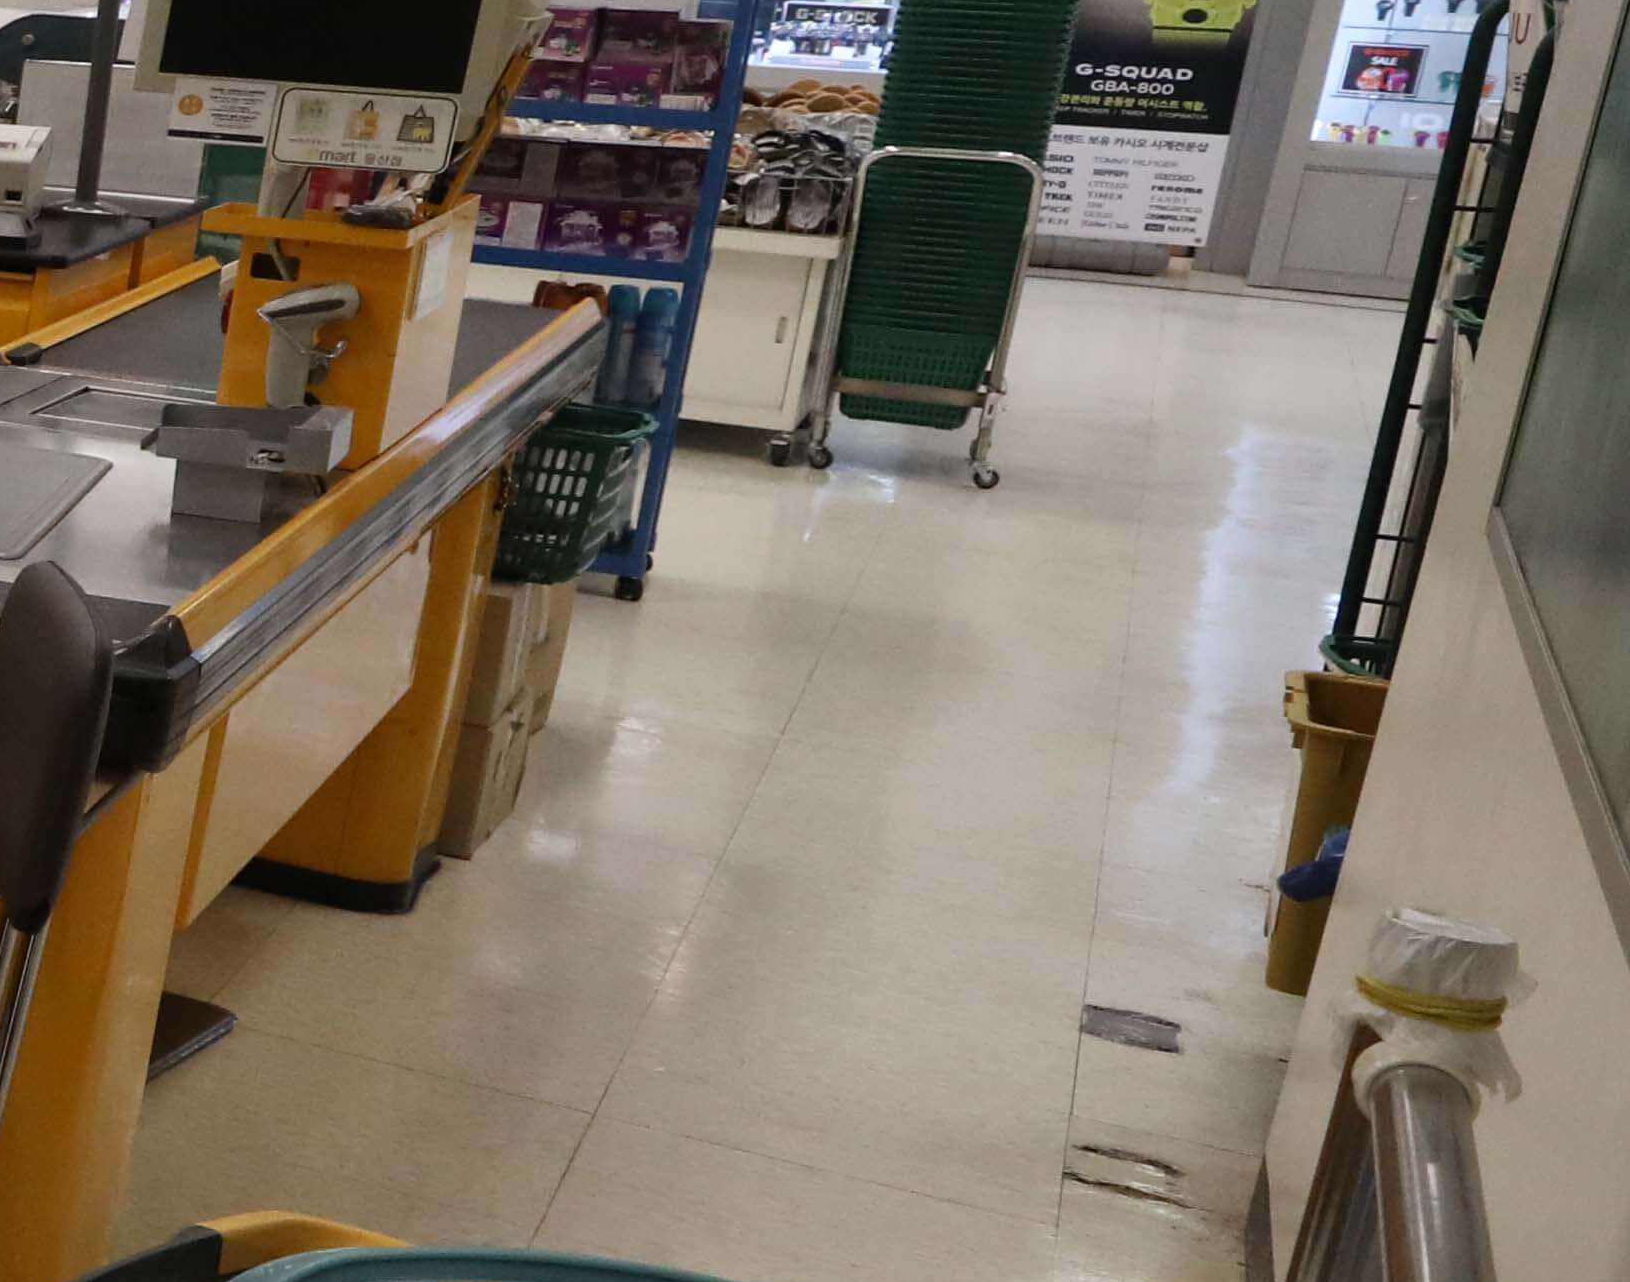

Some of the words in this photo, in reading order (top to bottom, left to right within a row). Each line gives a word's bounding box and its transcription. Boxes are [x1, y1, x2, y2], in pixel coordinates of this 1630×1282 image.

[1370, 55, 1399, 67] SALE
[1075, 62, 1194, 81] G-SQUAD
[1090, 79, 1175, 96] GBA-800
